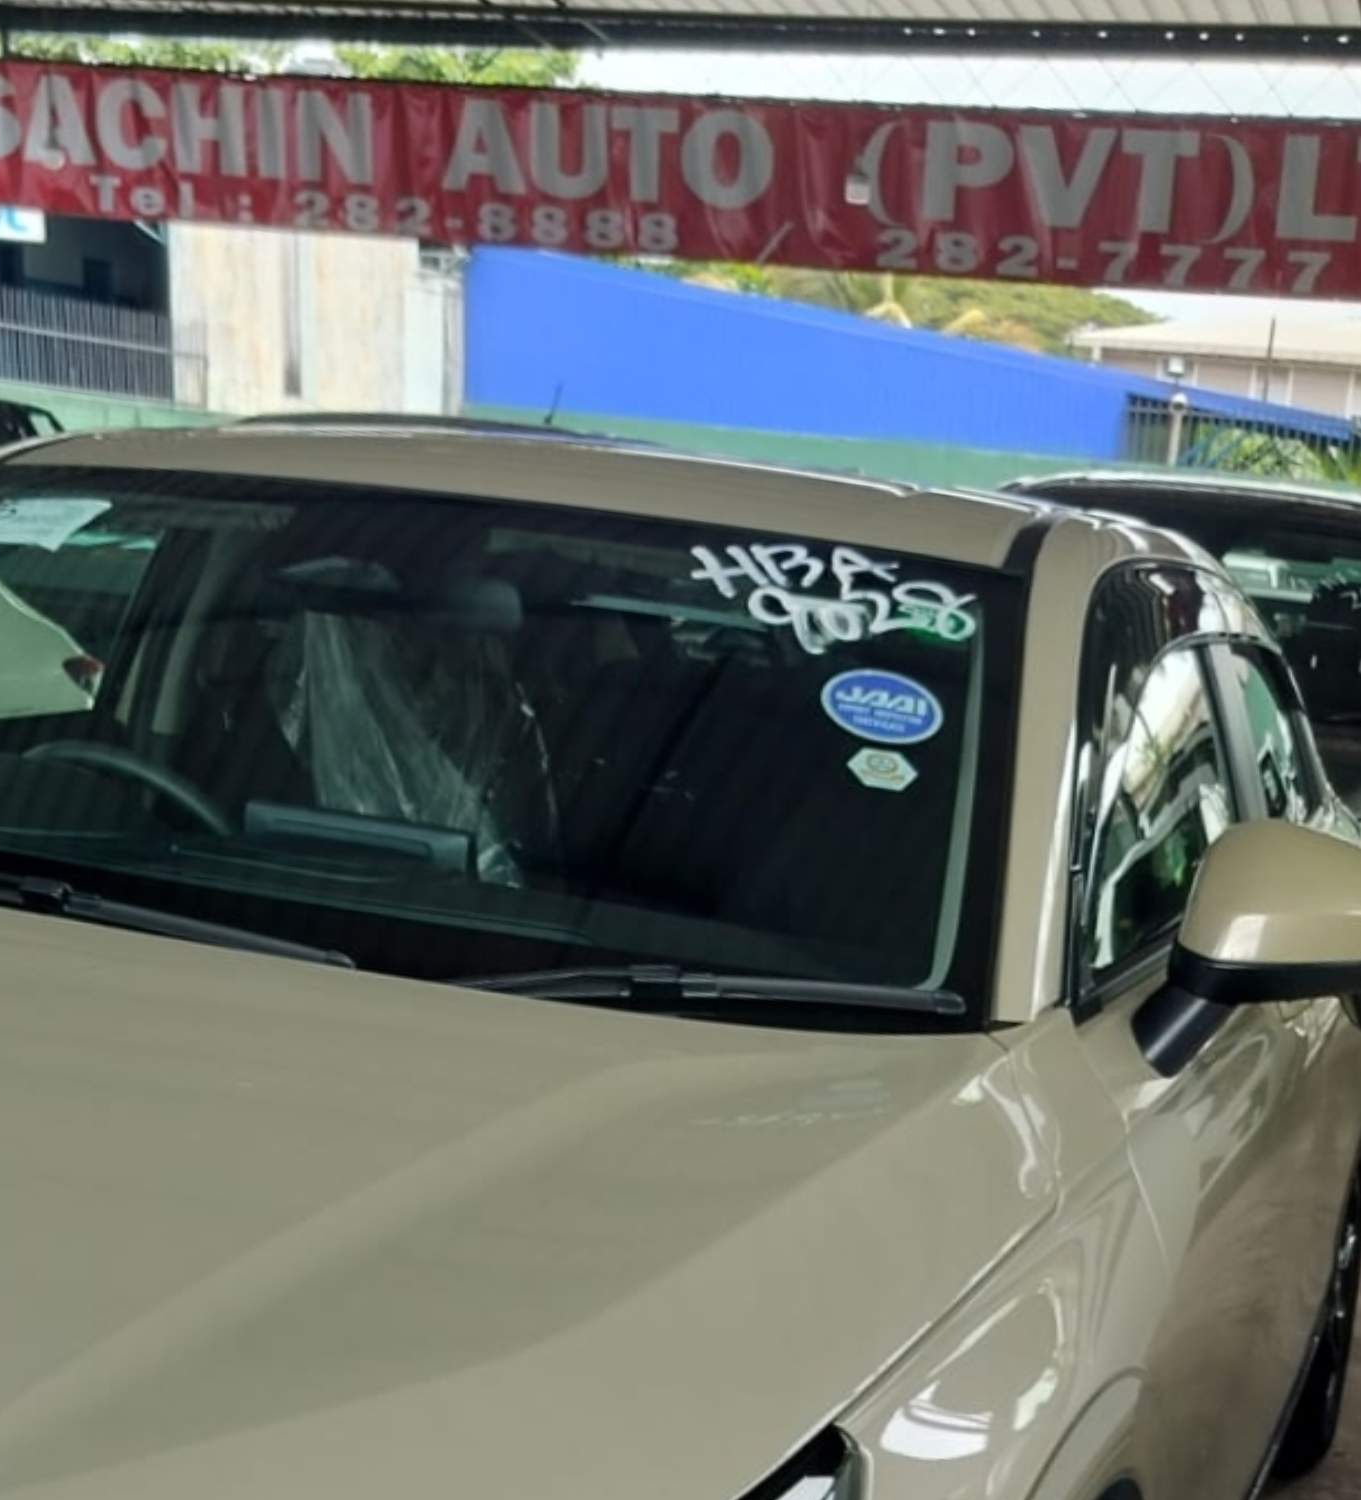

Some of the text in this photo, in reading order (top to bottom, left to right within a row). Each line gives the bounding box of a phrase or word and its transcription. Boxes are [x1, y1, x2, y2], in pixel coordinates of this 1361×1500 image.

[443, 99, 775, 210] AUTO
[295, 189, 678, 253] 282-8888
[876, 228, 1331, 292] 282-7777
